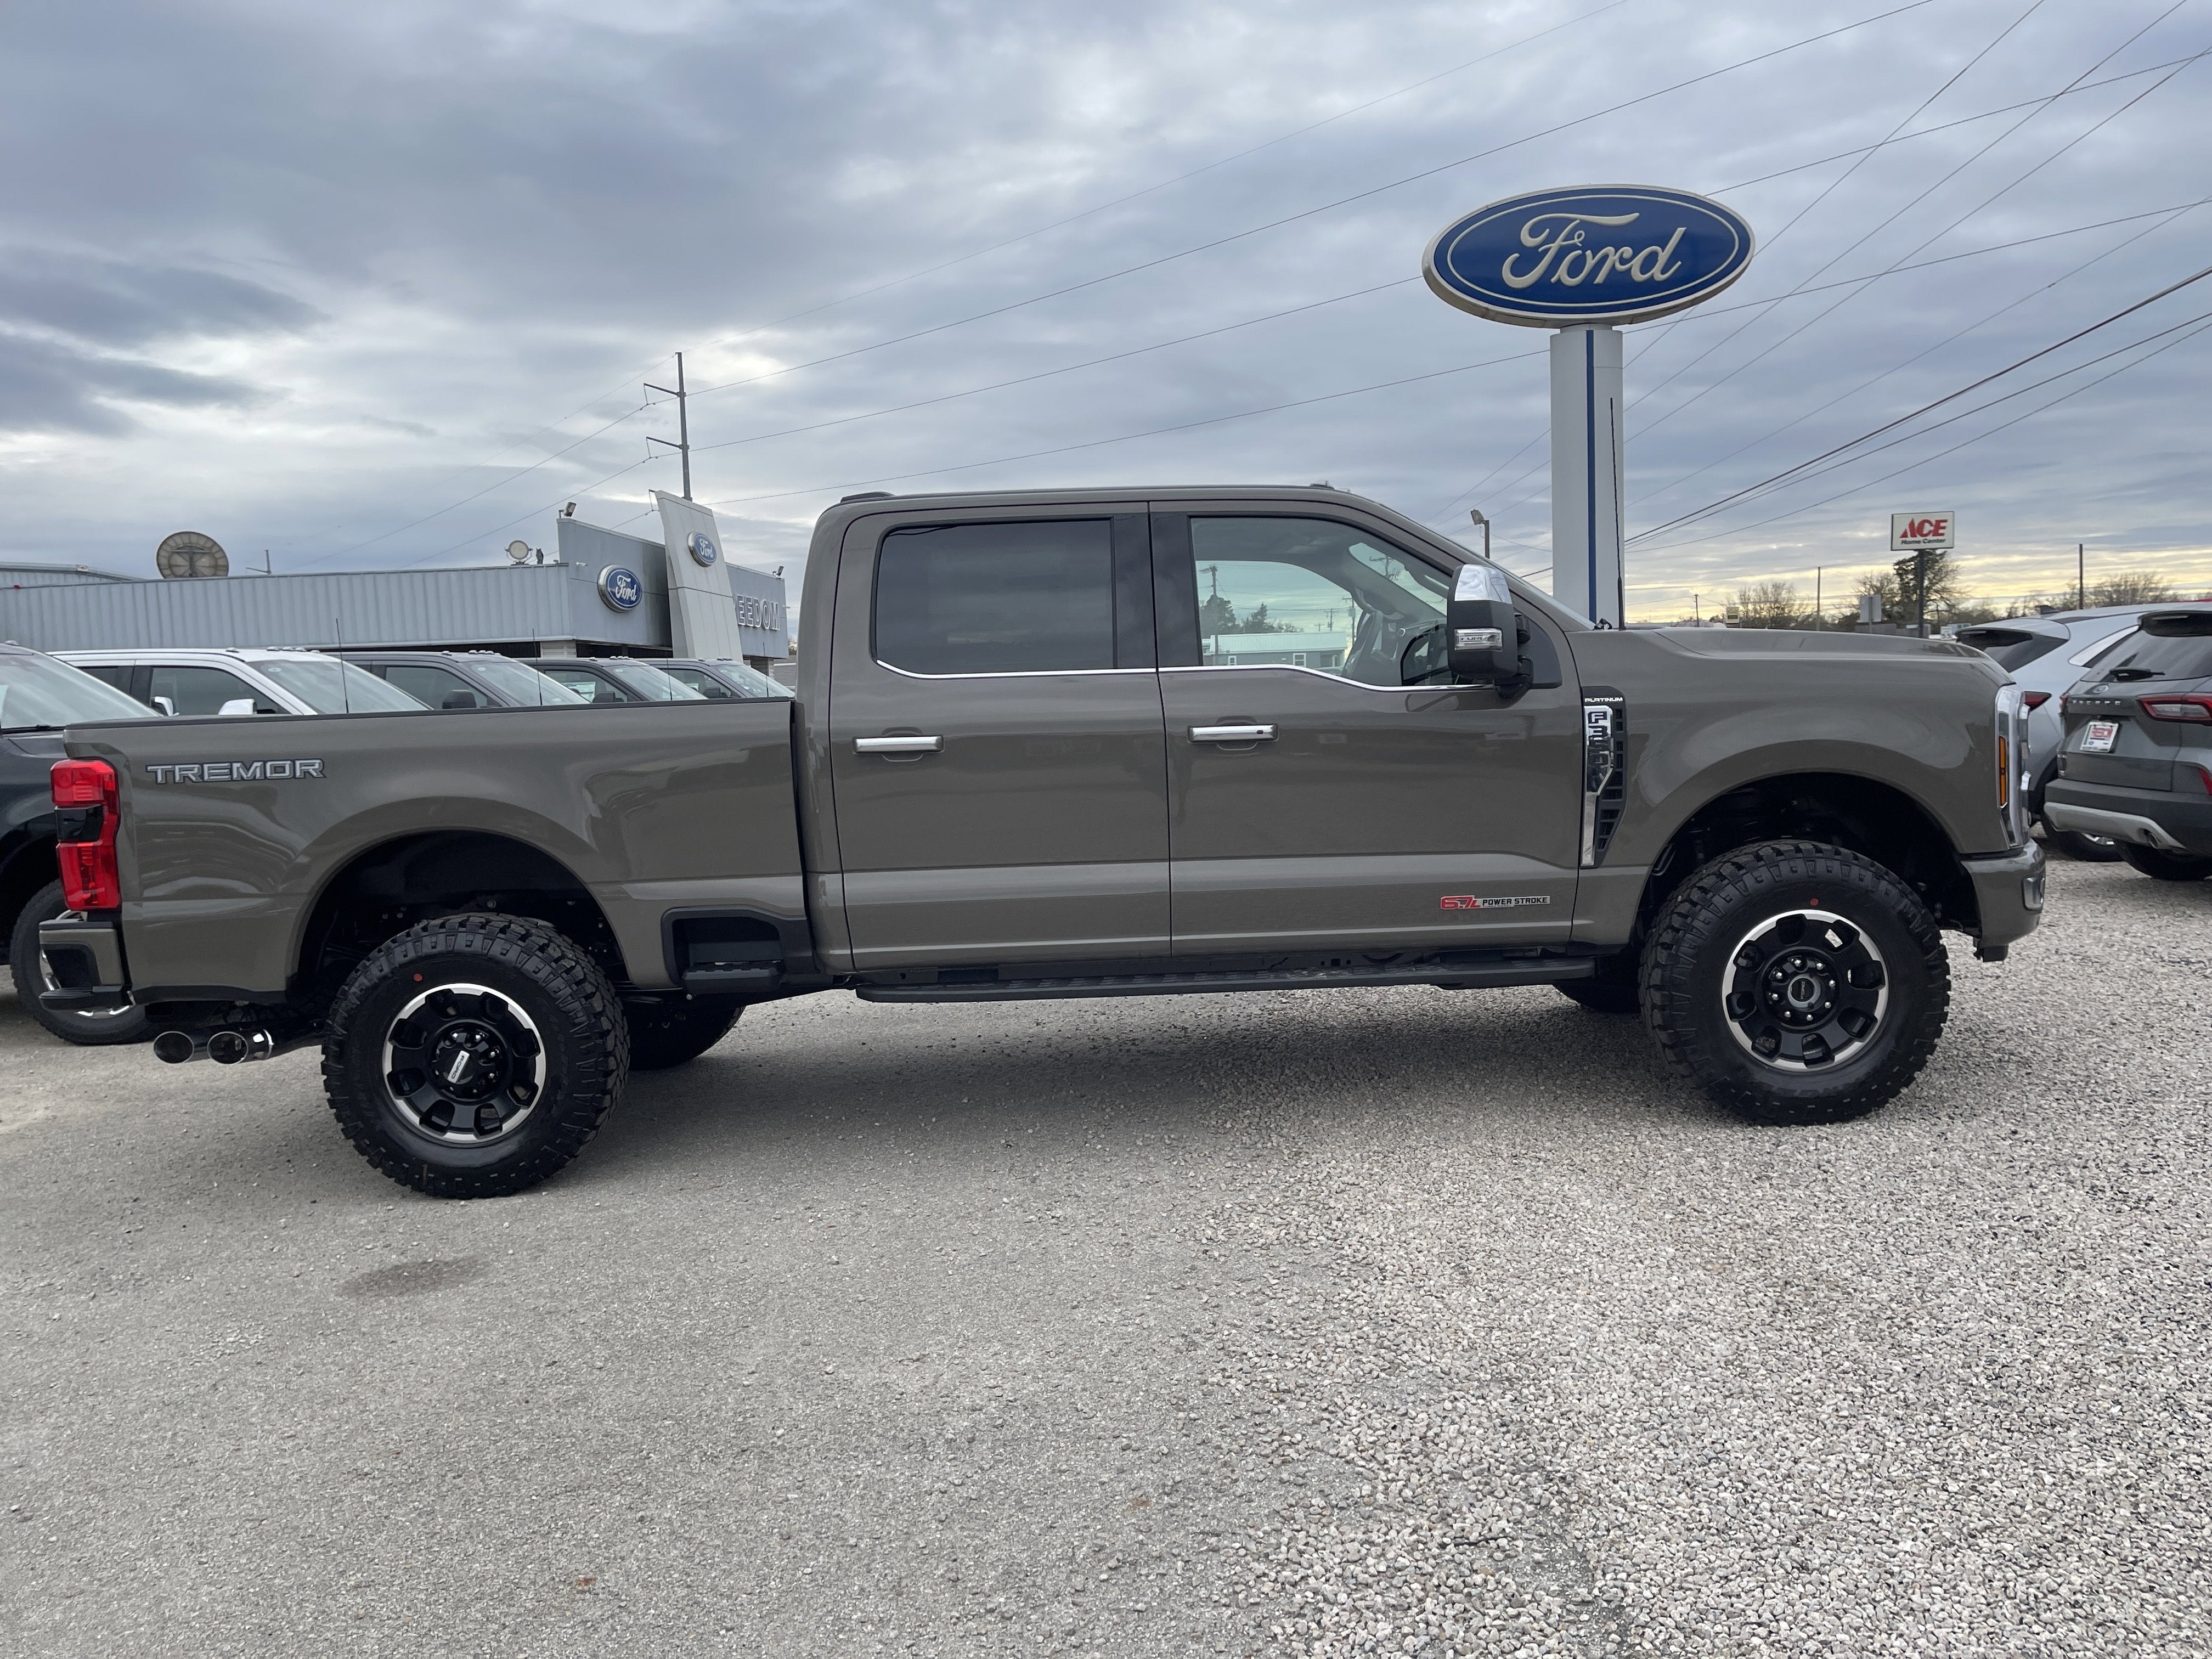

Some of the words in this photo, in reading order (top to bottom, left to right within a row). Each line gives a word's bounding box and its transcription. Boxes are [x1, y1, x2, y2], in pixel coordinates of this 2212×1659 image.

[1502, 212, 1687, 289] Ford
[1899, 517, 1948, 538] ACE
[699, 538, 714, 558] Ford
[615, 574, 637, 602] Ford
[146, 758, 327, 785] TREMOR
[451, 1055, 465, 1079] FORD
